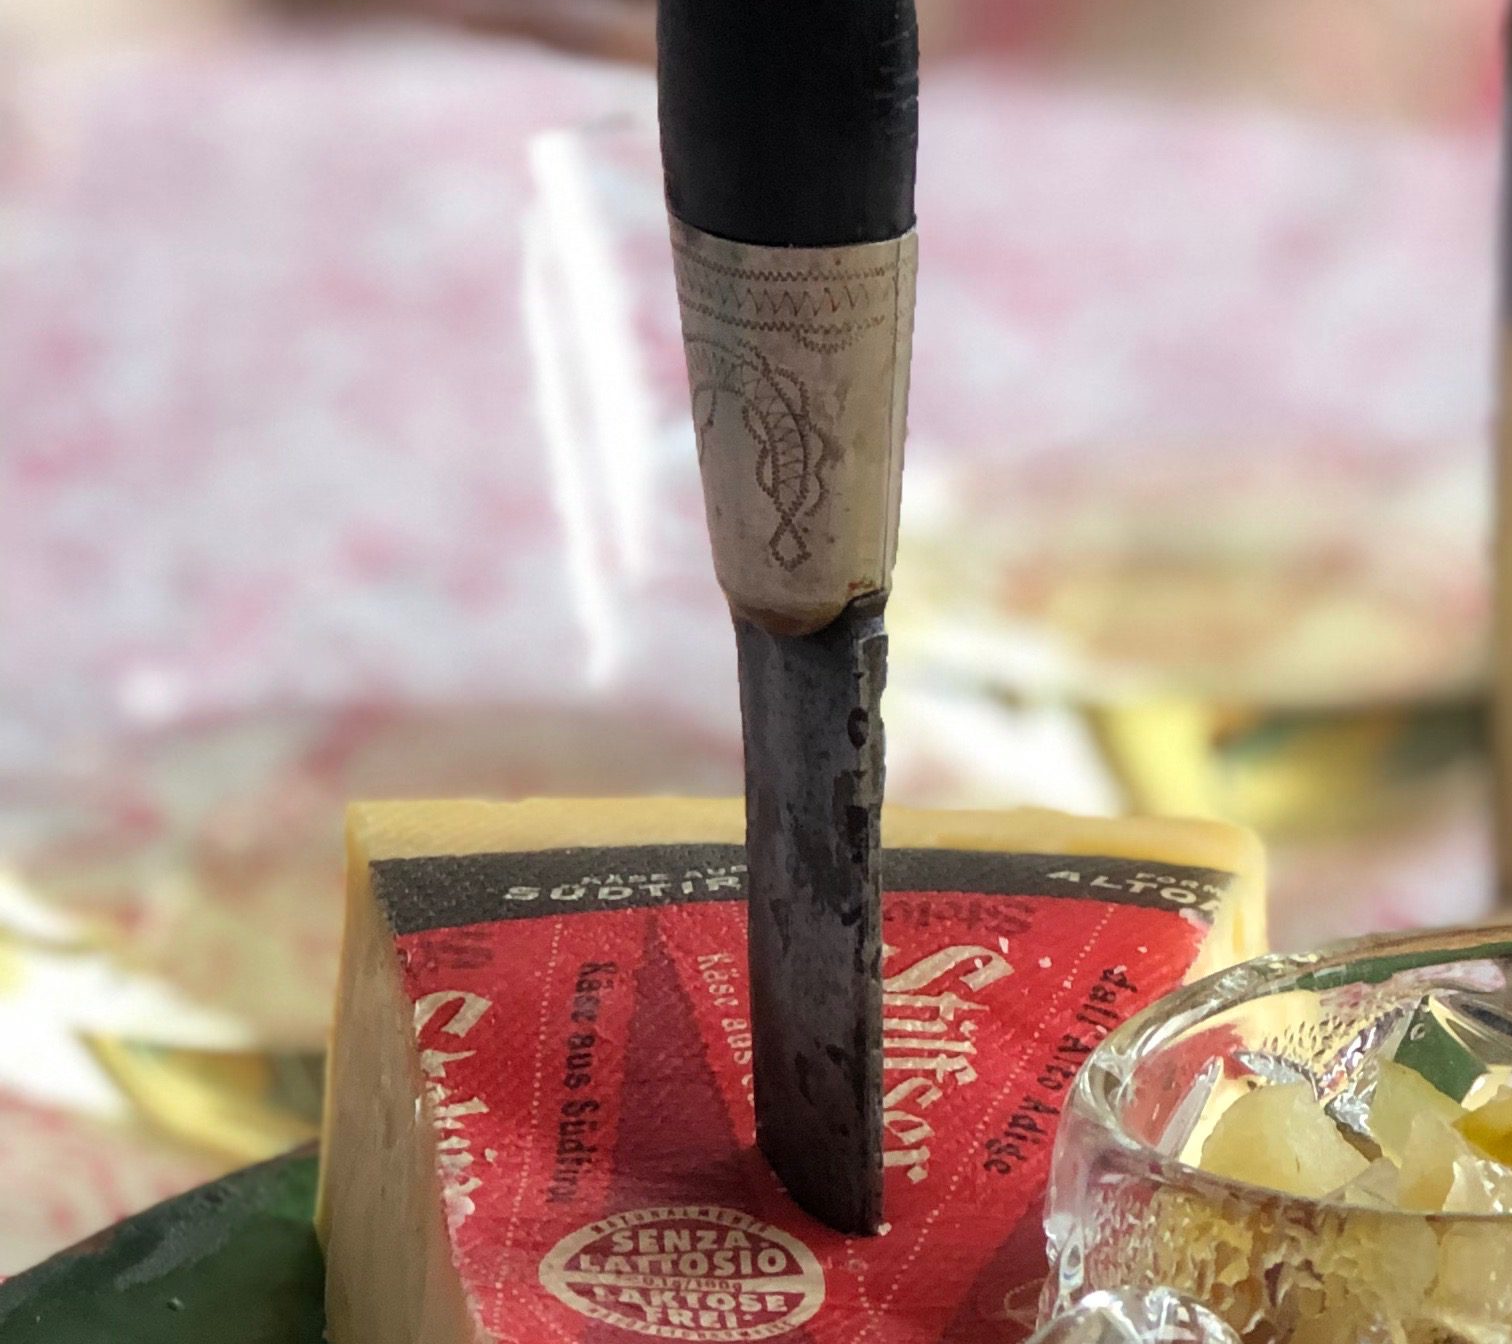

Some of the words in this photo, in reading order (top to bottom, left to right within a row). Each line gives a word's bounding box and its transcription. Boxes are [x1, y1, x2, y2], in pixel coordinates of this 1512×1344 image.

[1045, 869, 1198, 905] ALTO
[611, 1228, 751, 1254] SENZA
[579, 1247, 788, 1277] LATTOSIO
[592, 1285, 788, 1313] LAKTOSE
[646, 1308, 738, 1330] FREI
